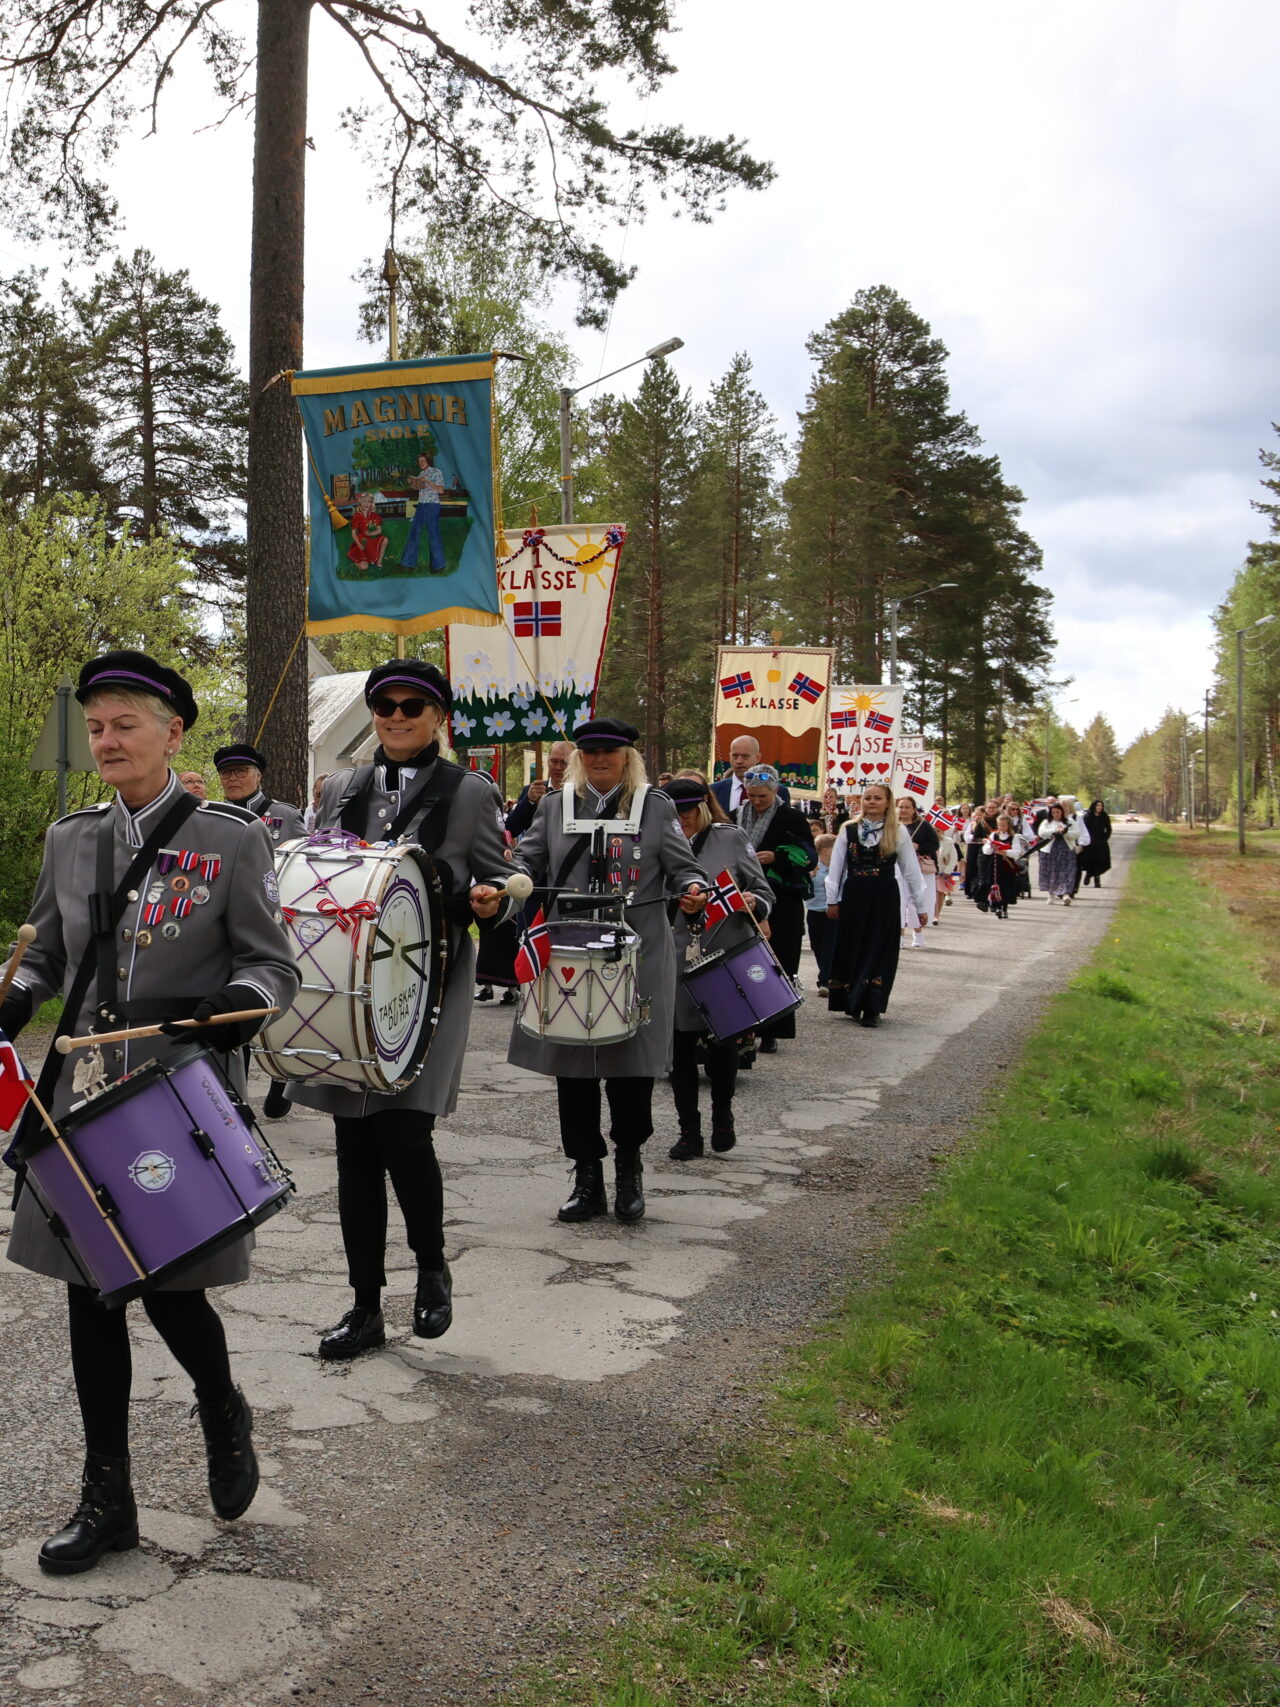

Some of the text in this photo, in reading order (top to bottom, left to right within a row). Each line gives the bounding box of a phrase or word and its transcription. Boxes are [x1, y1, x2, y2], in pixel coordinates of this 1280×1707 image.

[322, 393, 469, 437] MAGNOR
[365, 424, 430, 441] SKOLE
[532, 547, 542, 568] 1
[497, 570, 576, 591] KLASSE
[900, 741, 919, 749] sse
[896, 757, 931, 773] ASSE
[379, 983, 417, 1022] TAKT SKAR
[388, 1010, 399, 1031] DU
[400, 1003, 410, 1021] HA
